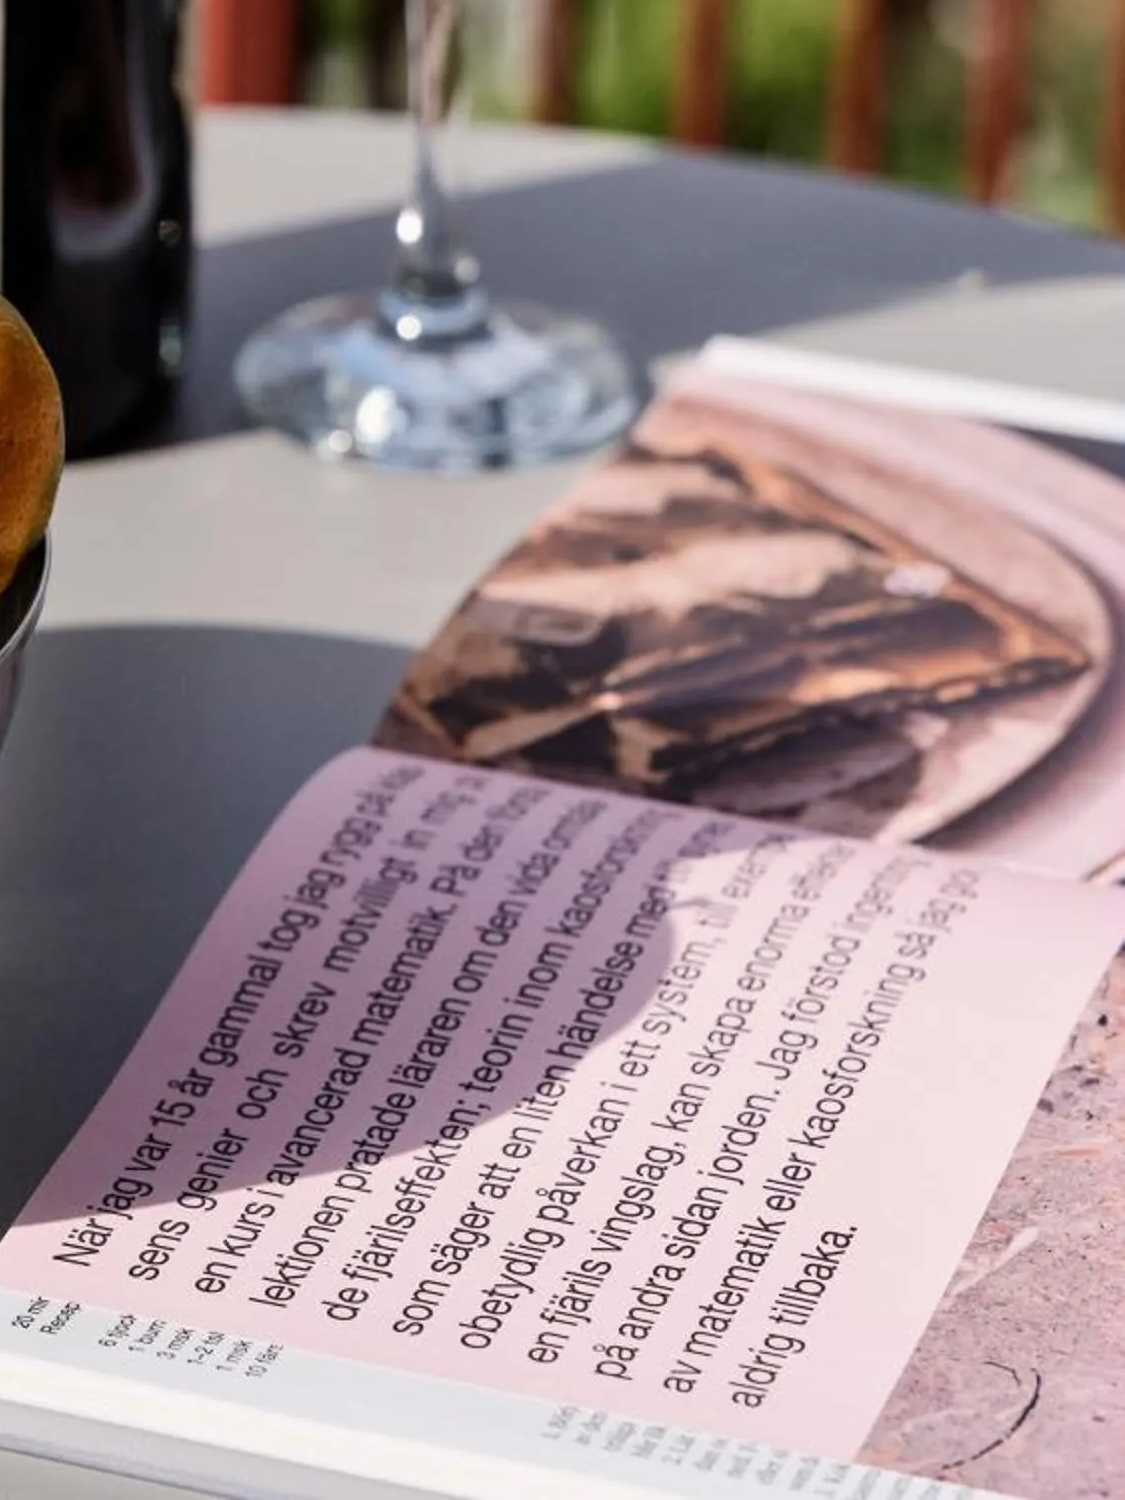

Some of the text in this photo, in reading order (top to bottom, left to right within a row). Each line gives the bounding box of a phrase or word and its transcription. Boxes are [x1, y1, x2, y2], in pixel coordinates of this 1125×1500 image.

[319, 818, 382, 867] rygg
[457, 825, 507, 863] den
[283, 868, 346, 911] jag
[429, 865, 480, 897] På
[257, 908, 320, 952] tog
[624, 885, 675, 938] med
[907, 899, 967, 934] jag
[736, 905, 810, 992] enorma
[895, 932, 936, 959] så
[350, 904, 457, 1046] matematik.
[503, 942, 573, 1009] inom
[545, 942, 644, 1060] händelse
[780, 935, 861, 1024] förstod
[198, 954, 281, 1068] gammal
[688, 997, 756, 1077] skapa
[128, 1219, 190, 1281] sens
[177, 1128, 248, 1213] genier
[236, 1069, 289, 1120] och
[272, 981, 336, 1059] skrev
[322, 857, 417, 973] motvilligt
[389, 830, 434, 849] in
[248, 1195, 355, 1308] lektionen
[334, 1093, 417, 1194] pratade
[387, 998, 471, 1089] läraren
[452, 950, 497, 993] om
[475, 901, 527, 947] den
[506, 853, 560, 896] vida
[458, 1014, 533, 1093] teorin
[755, 1029, 818, 1081] Jag
[787, 964, 926, 1149] kaosforskning
[167, 1067, 215, 1098] år
[512, 1065, 575, 1121] liten
[651, 1083, 710, 1133] kan
[149, 1099, 196, 1127] 15
[266, 1048, 371, 1186] avancerad
[697, 1090, 780, 1186] jorden.
[124, 1133, 172, 1171] var
[459, 1227, 565, 1349] obetydlig
[535, 1099, 629, 1226] påverkan
[600, 1081, 638, 1092] i
[619, 1040, 661, 1077] ett
[641, 938, 725, 1036] system,
[502, 1126, 542, 1159] en
[87, 1177, 154, 1221] jag
[247, 1187, 284, 1199] i
[341, 1100, 491, 1282] fjärilseffekten;
[478, 1163, 521, 1200] att
[589, 1142, 686, 1252] vingslag,
[762, 1152, 816, 1212] eller
[52, 1218, 114, 1267] När
[207, 1202, 276, 1257] kurs
[430, 1201, 495, 1275] säger
[662, 1187, 728, 1259] sidan
[194, 1261, 238, 1293] en
[321, 1288, 369, 1321] de
[539, 1259, 612, 1327] fjärils
[618, 1264, 686, 1340] andra
[683, 1216, 786, 1357] matematik
[392, 1279, 451, 1336] som
[729, 1226, 857, 1408] aldrig tillbaka.
[527, 1331, 569, 1363] en
[592, 1344, 639, 1381] på
[663, 1359, 702, 1393] av
